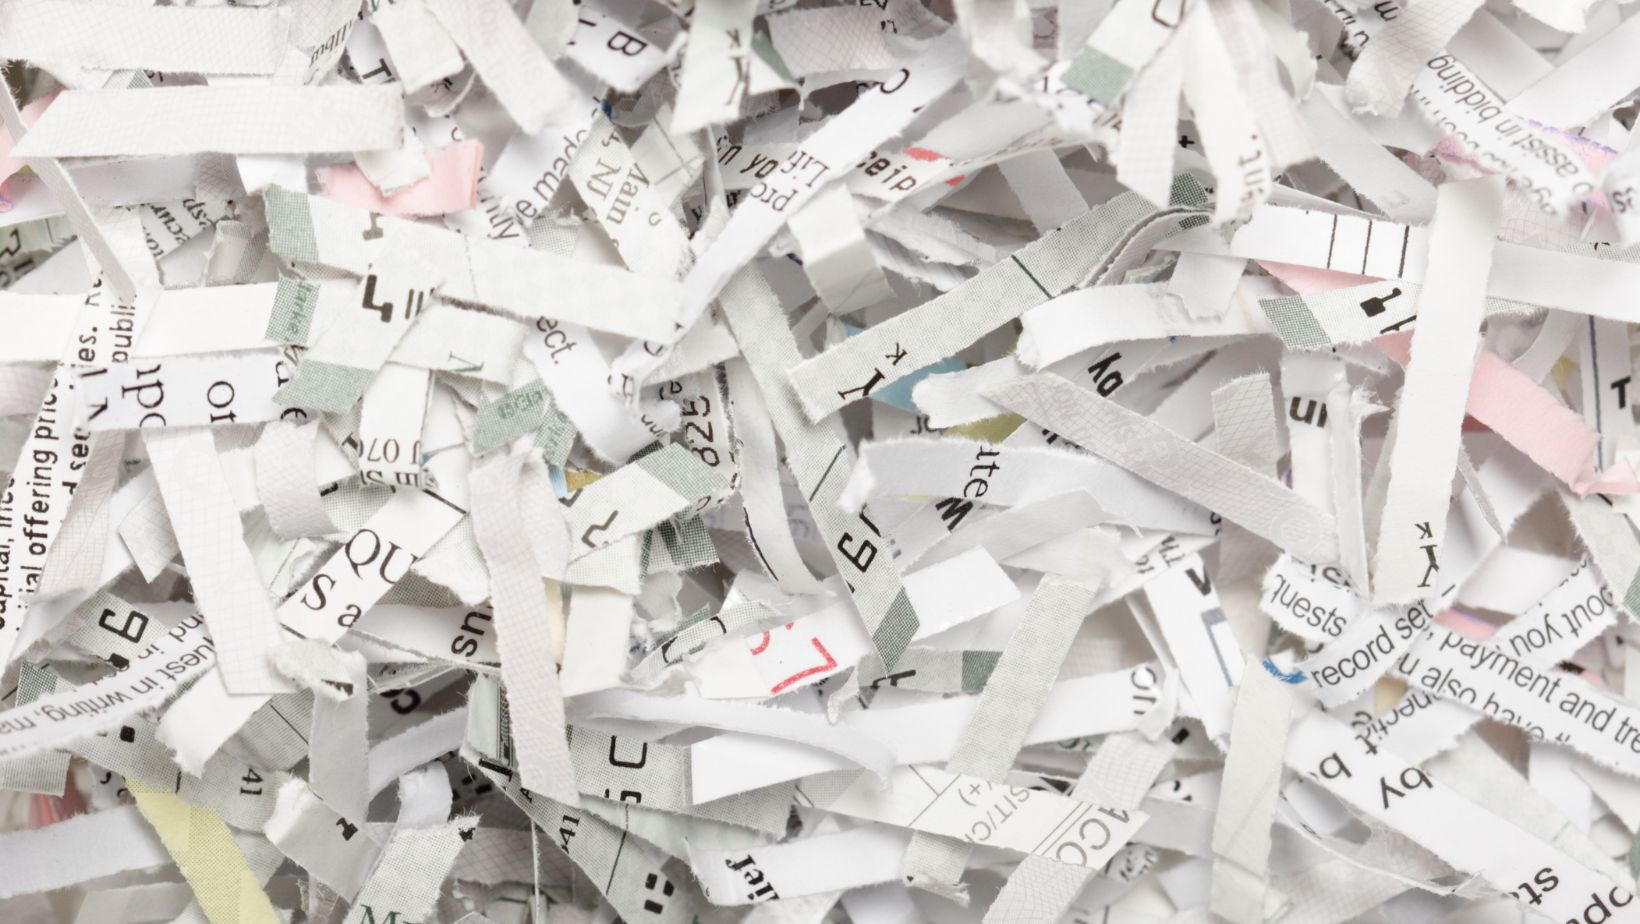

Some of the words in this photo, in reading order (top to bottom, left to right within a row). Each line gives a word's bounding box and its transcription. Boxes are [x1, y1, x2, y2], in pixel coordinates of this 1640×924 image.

[1427, 54, 1502, 124] bidding
[1495, 119, 1523, 144] in
[1511, 134, 1579, 178] assist
[359, 439, 400, 464] 07
[24, 450, 59, 556] offering
[1311, 624, 1395, 689] record
[1510, 613, 1562, 658] you
[129, 674, 159, 697] in
[1421, 666, 1478, 706] also
[1440, 632, 1562, 704] payment
[1560, 691, 1616, 732] and
[34, 690, 134, 724] writing,
[1381, 768, 1435, 809] by
